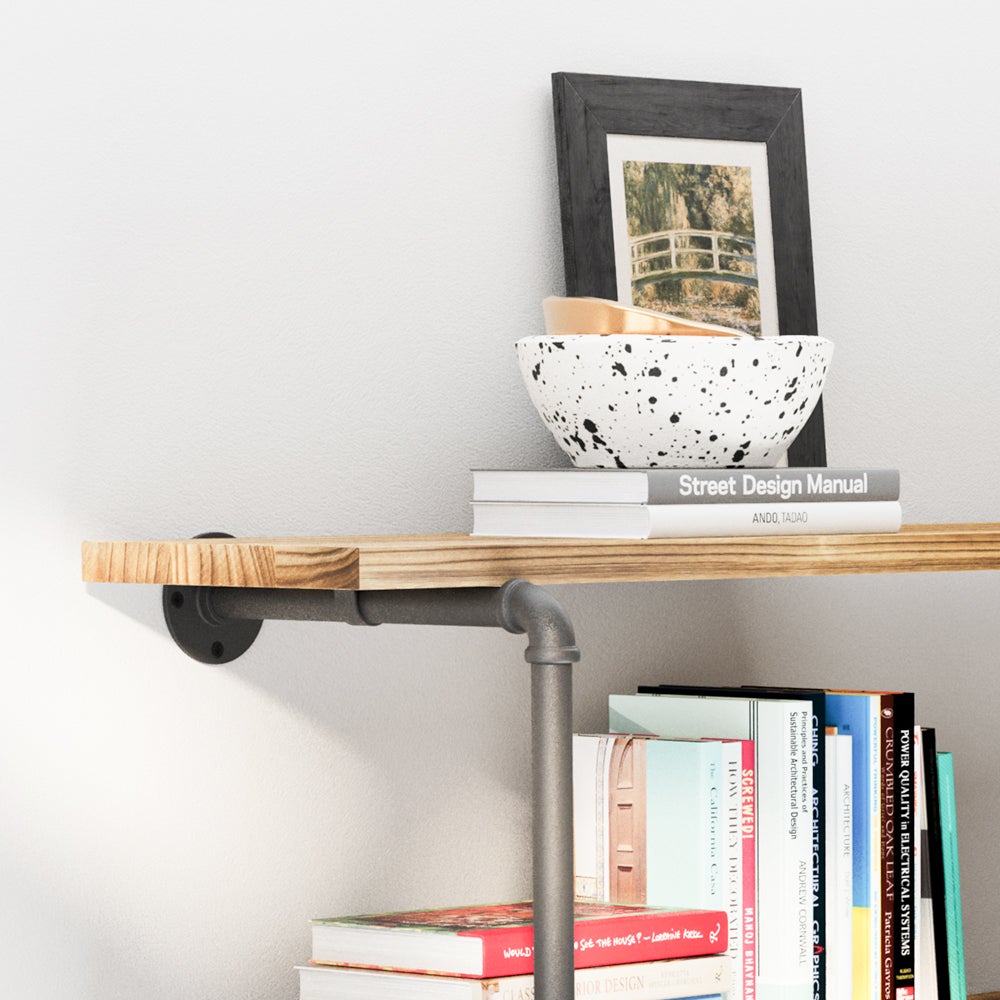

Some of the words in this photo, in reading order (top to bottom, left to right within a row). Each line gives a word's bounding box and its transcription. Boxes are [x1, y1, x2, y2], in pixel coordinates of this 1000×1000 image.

[679, 474, 737, 496] Street
[742, 474, 803, 500] Design
[806, 472, 868, 495] Manual
[782, 511, 808, 524] TADAO
[790, 712, 798, 756] Sustainable
[800, 711, 808, 748] Principles
[900, 729, 910, 768] POWER
[790, 757, 798, 810] Architectural
[885, 726, 894, 817] CRUMBLED
[801, 803, 808, 813] of
[898, 769, 910, 819] QUALITY
[788, 811, 798, 840] Design
[842, 784, 850, 857] ARCHITECTURE
[885, 820, 894, 857] OAK
[900, 821, 910, 831] in
[799, 860, 807, 905] ANDREW
[886, 861, 894, 901] LEAF
[900, 833, 911, 902] ELECTRICAL
[744, 907, 754, 944] MANOJ
[799, 909, 807, 966] CORNWALL
[884, 912, 892, 955] Patricia
[900, 904, 911, 956] SYSTEMS
[503, 946, 532, 959] WOULD
[605, 976, 645, 993] DESIGN
[884, 957, 893, 1000] Gavros
